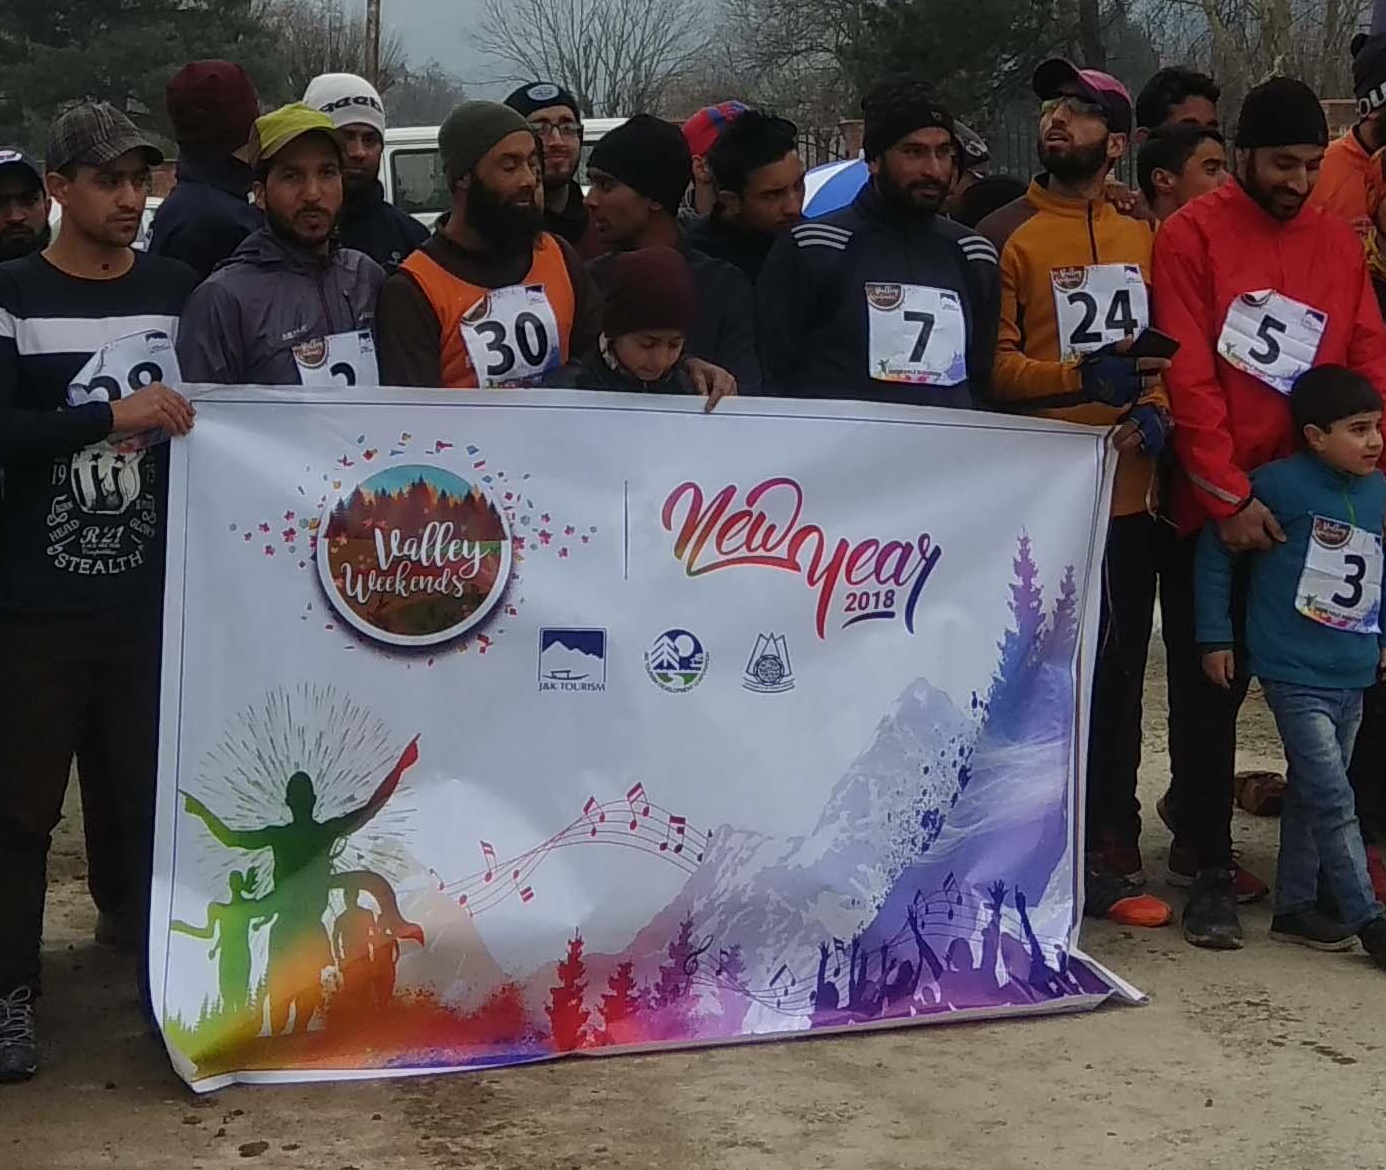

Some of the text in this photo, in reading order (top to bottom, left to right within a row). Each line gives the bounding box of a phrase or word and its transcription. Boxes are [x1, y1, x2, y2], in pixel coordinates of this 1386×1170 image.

[903, 310, 935, 363] 7
[1067, 289, 1139, 345] 24
[1248, 313, 1287, 365] 5
[473, 312, 548, 376] 30
[374, 521, 491, 579] Valley
[662, 477, 803, 577] New
[54, 551, 144, 575] STEALTH
[340, 560, 466, 604] Weekends
[1331, 554, 1366, 608] 3
[844, 589, 896, 613] 2018
[560, 682, 606, 692] TOURISM
